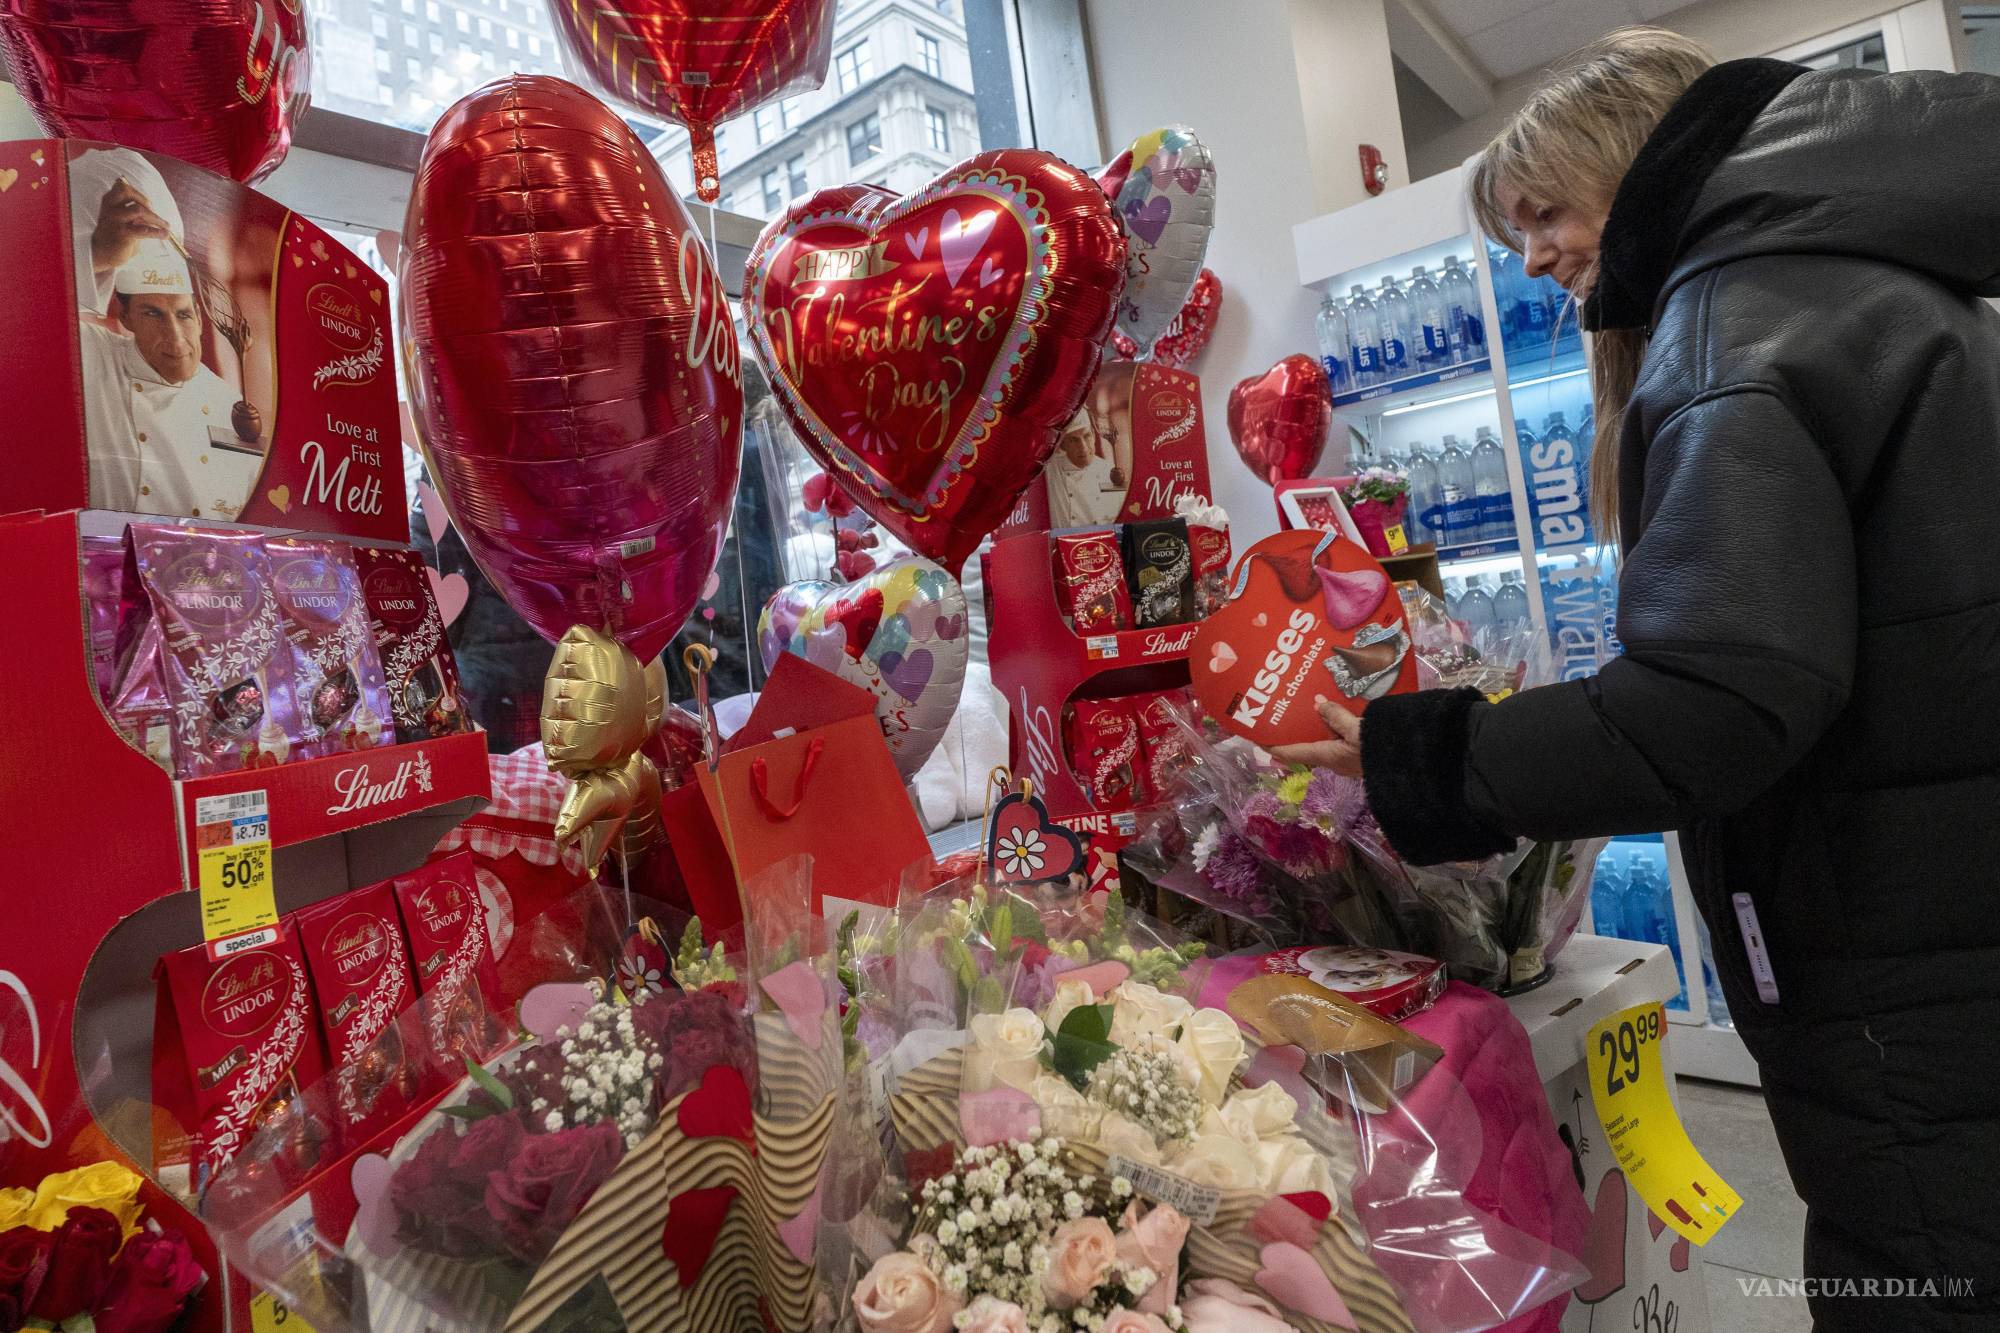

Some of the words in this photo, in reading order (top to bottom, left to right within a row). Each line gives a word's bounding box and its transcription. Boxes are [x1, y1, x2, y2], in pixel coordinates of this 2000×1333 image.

[804, 250, 877, 281] HAPPY
[317, 292, 352, 320] Lindt
[321, 315, 361, 340] LINDOR
[769, 272, 1008, 384] Valentine's
[859, 356, 966, 452] Day
[1156, 409, 1182, 417] LINDOR
[327, 413, 362, 439] Love
[365, 427, 379, 443] at
[351, 443, 382, 468] First
[1160, 460, 1182, 470] Love
[1184, 460, 1192, 469] at
[300, 440, 383, 516] Melt
[1175, 471, 1194, 482] First
[1150, 550, 1175, 559] LINDOR
[184, 594, 244, 609] LINDOR
[292, 596, 338, 608] LINDOR
[379, 600, 416, 611] LINDOR
[1142, 631, 1192, 657] Lindt
[1269, 697, 1290, 726] milk
[1286, 637, 1326, 697] chocolate
[326, 761, 413, 816] Lindt
[252, 871, 264, 883] off
[429, 909, 463, 933] LINDOR
[225, 931, 266, 952] special
[332, 925, 365, 954] Lindt
[337, 944, 379, 974] LINDOR
[426, 954, 441, 973] MILK
[217, 964, 261, 1003] Lindt
[223, 988, 276, 1024] LINDOR
[334, 999, 351, 1021] MILK
[211, 1053, 239, 1081] MILK
